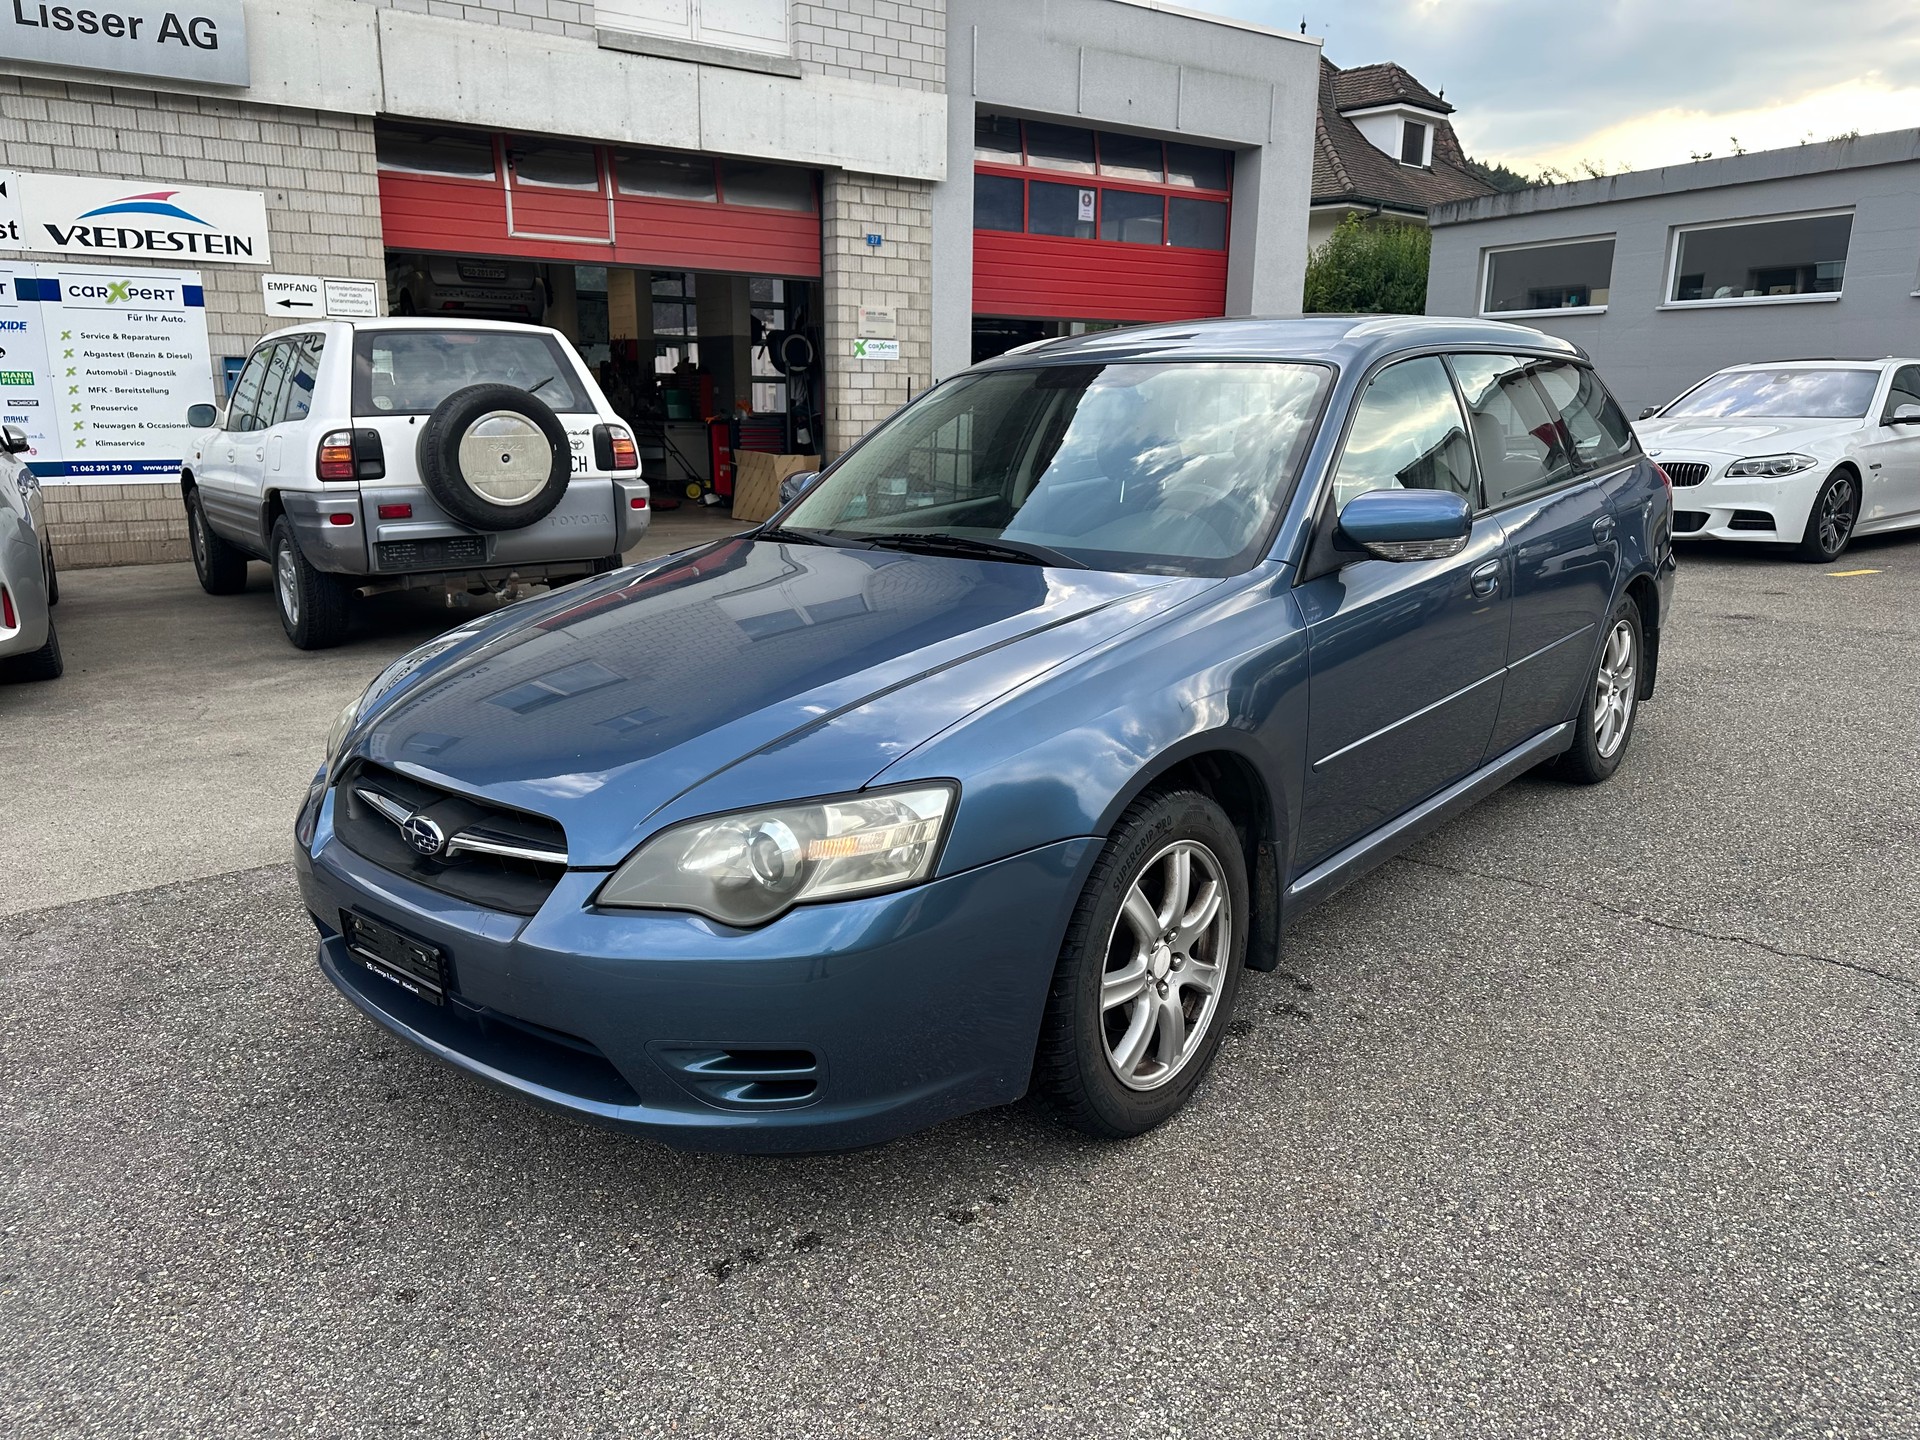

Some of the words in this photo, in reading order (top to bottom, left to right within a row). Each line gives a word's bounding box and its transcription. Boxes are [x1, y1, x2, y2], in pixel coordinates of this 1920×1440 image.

[12, 0, 143, 40] Lisser
[157, 12, 218, 50] AG
[43, 223, 253, 256] VREDESTEIN
[870, 236, 878, 244] 37
[267, 282, 317, 293] EMPFANG
[330, 298, 368, 306] Voranmeldung
[127, 313, 143, 321] Für
[146, 314, 158, 322] Ihr
[161, 315, 186, 323] Auto.
[80, 332, 110, 340] Service
[121, 333, 170, 342] Reparaturen
[83, 350, 125, 359] Abgastest
[127, 351, 156, 359] (Benzin
[166, 352, 193, 360] Diesel)
[135, 369, 177, 378] Diagnostik
[114, 387, 170, 395] Bereitstellung
[90, 404, 139, 412] Pneuservice
[93, 422, 136, 430] Neuwagen
[570, 455, 588, 473] CH
[550, 513, 610, 526] TOYOTA
[1113, 829, 1154, 893] SUPERGRIP
[1154, 815, 1172, 834] PRO
